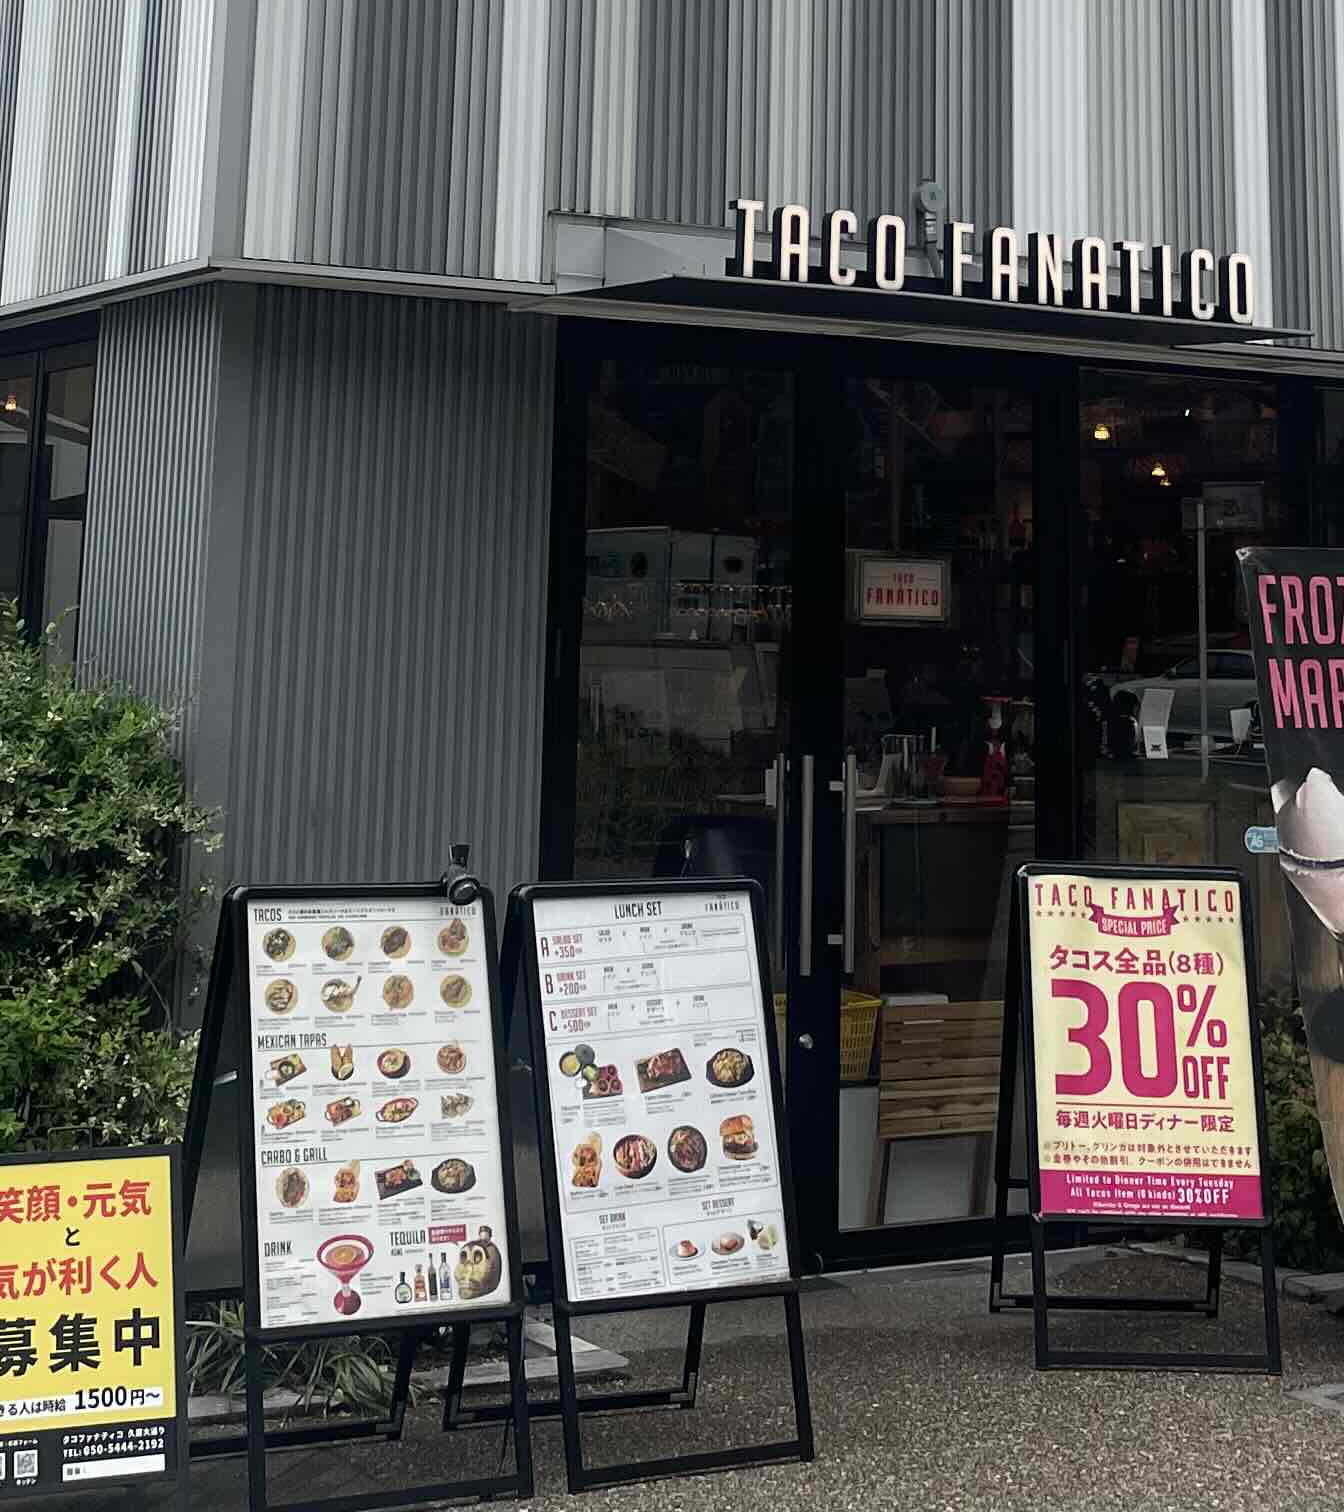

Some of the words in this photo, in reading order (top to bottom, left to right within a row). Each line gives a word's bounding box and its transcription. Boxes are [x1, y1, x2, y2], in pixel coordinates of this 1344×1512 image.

[734, 199, 906, 291] TACO
[950, 222, 1255, 324] FANATICO
[1035, 884, 1093, 907] TACO
[1111, 887, 1233, 912] FANATICO
[254, 908, 282, 922] TACOS
[614, 902, 644, 919] LUNCH
[646, 901, 662, 916] SET
[1102, 917, 1138, 935] SPECIAL
[1141, 919, 1168, 936] PRICE
[541, 937, 549, 957] A
[1050, 945, 1224, 976] タコス全品(8種)
[545, 974, 553, 994] B
[549, 1010, 557, 1031] C
[257, 1035, 297, 1049] MEXICAN
[299, 1033, 327, 1048] TAPAS
[1051, 978, 1228, 1098] 30%
[1182, 1055, 1230, 1099] OFF
[1056, 1110, 1235, 1132] 毎週火曜日ディナー限定
[261, 1149, 291, 1165] CARBO
[303, 1147, 327, 1162] GRILL
[1066, 1174, 1099, 1185] Limited
[1115, 1175, 1143, 1185] Dinner
[1147, 1176, 1167, 1186] Time
[1171, 1176, 1195, 1188] Every
[1198, 1178, 1234, 1190] Tuesday
[1071, 1188, 1083, 1198] All
[1178, 1188, 1229, 1204] 30%OFF
[64, 1227, 81, 1247] と
[390, 1230, 426, 1246] TEQUILA
[264, 1240, 292, 1257] DRINK
[63, 1430, 123, 1445] タコファナティコ
